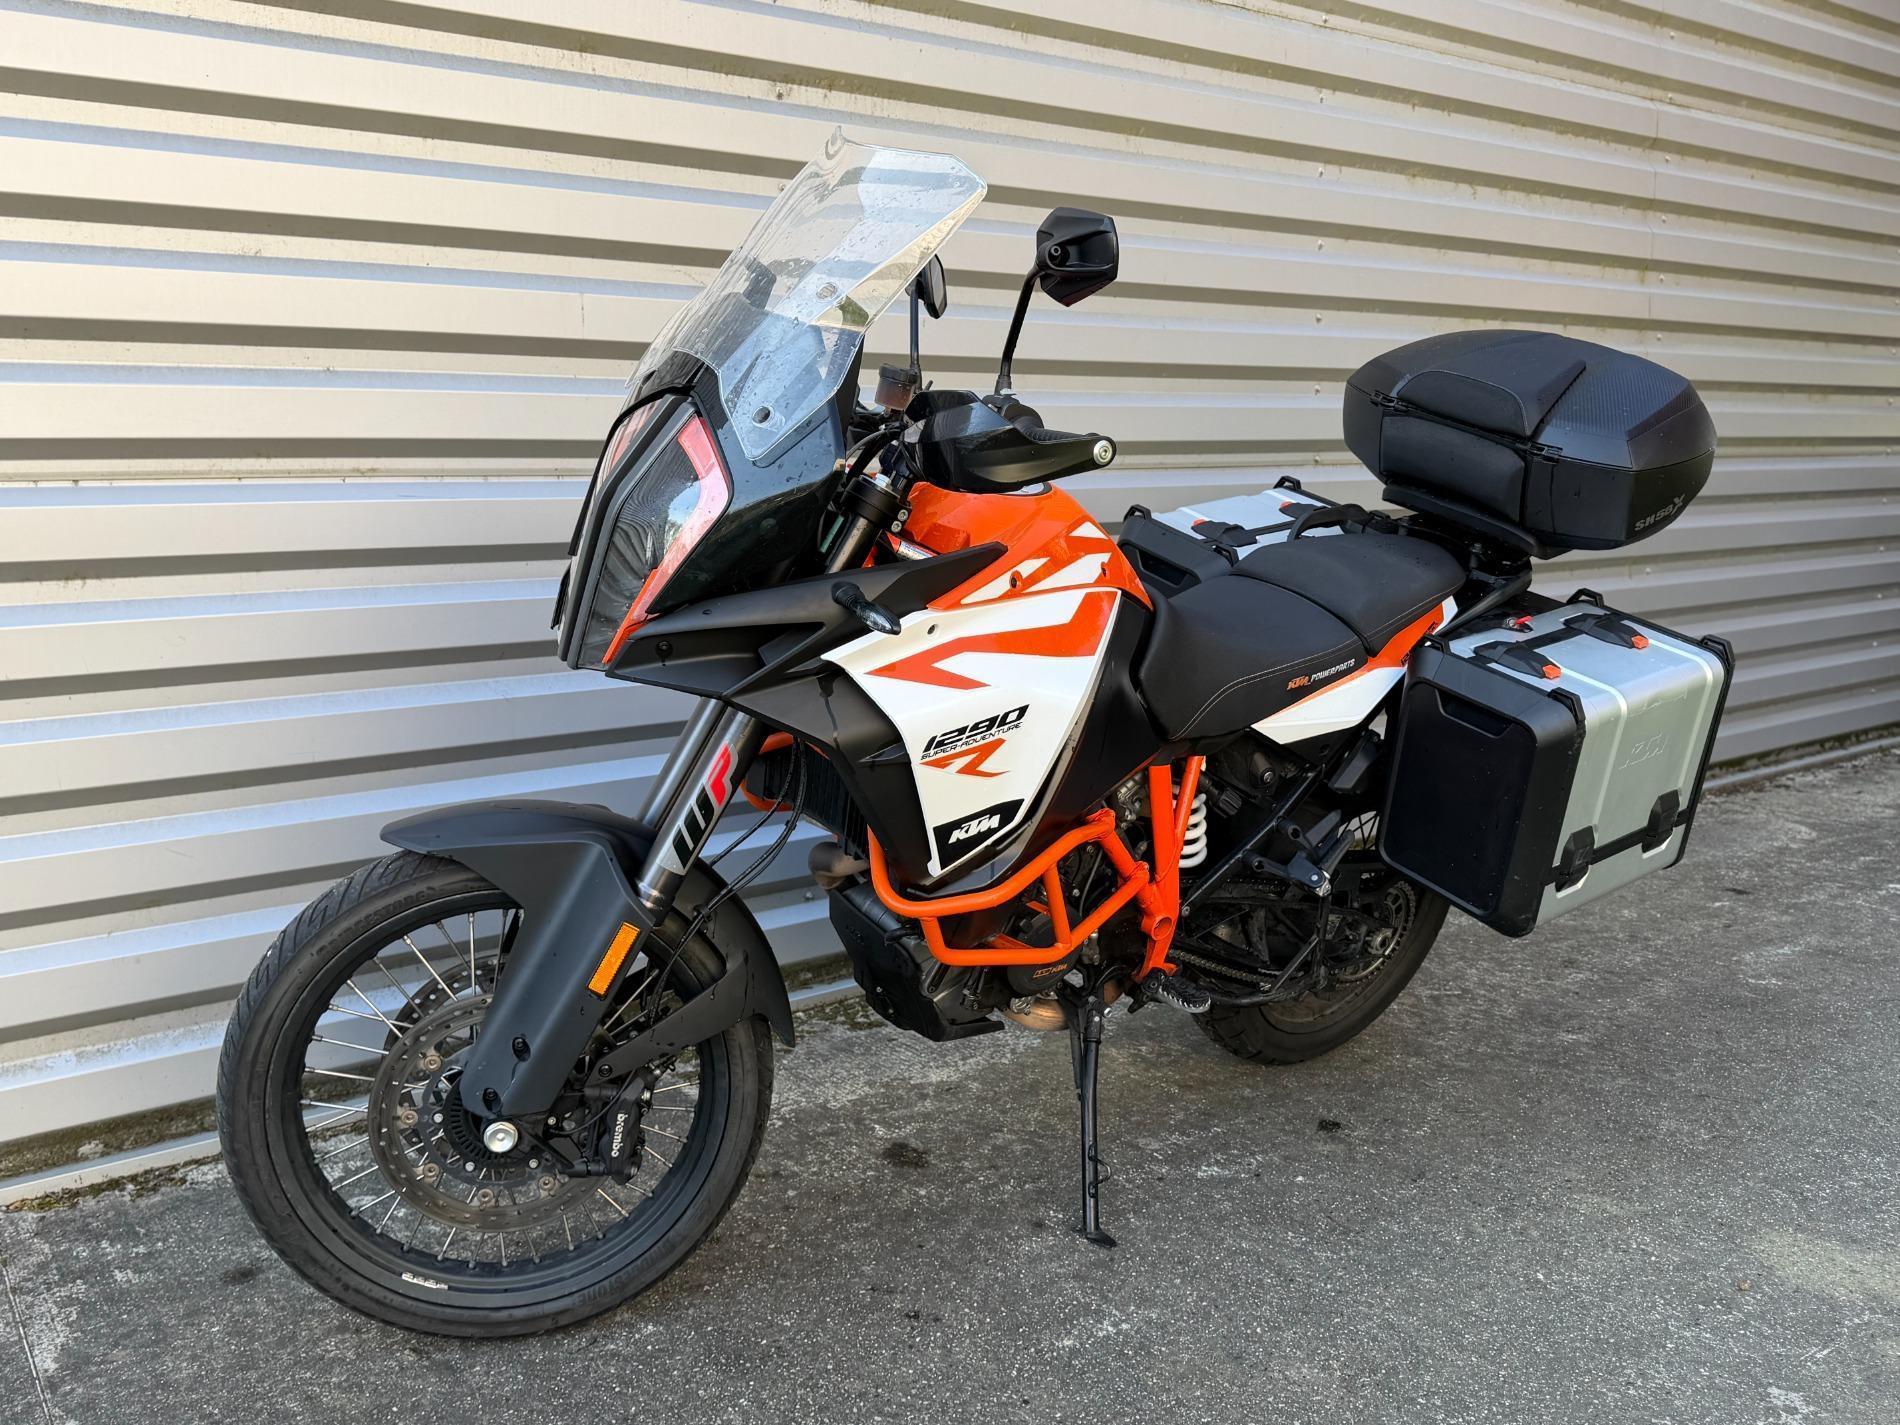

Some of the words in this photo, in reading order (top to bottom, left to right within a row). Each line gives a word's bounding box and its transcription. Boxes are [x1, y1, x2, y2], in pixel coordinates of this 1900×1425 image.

[1310, 658, 1356, 682] POWERPARTS
[920, 721, 1023, 761] SUPER-ADVENTURE
[922, 703, 1031, 753] 1290
[948, 813, 1001, 845] KTM
[611, 1112, 629, 1158] brembo
